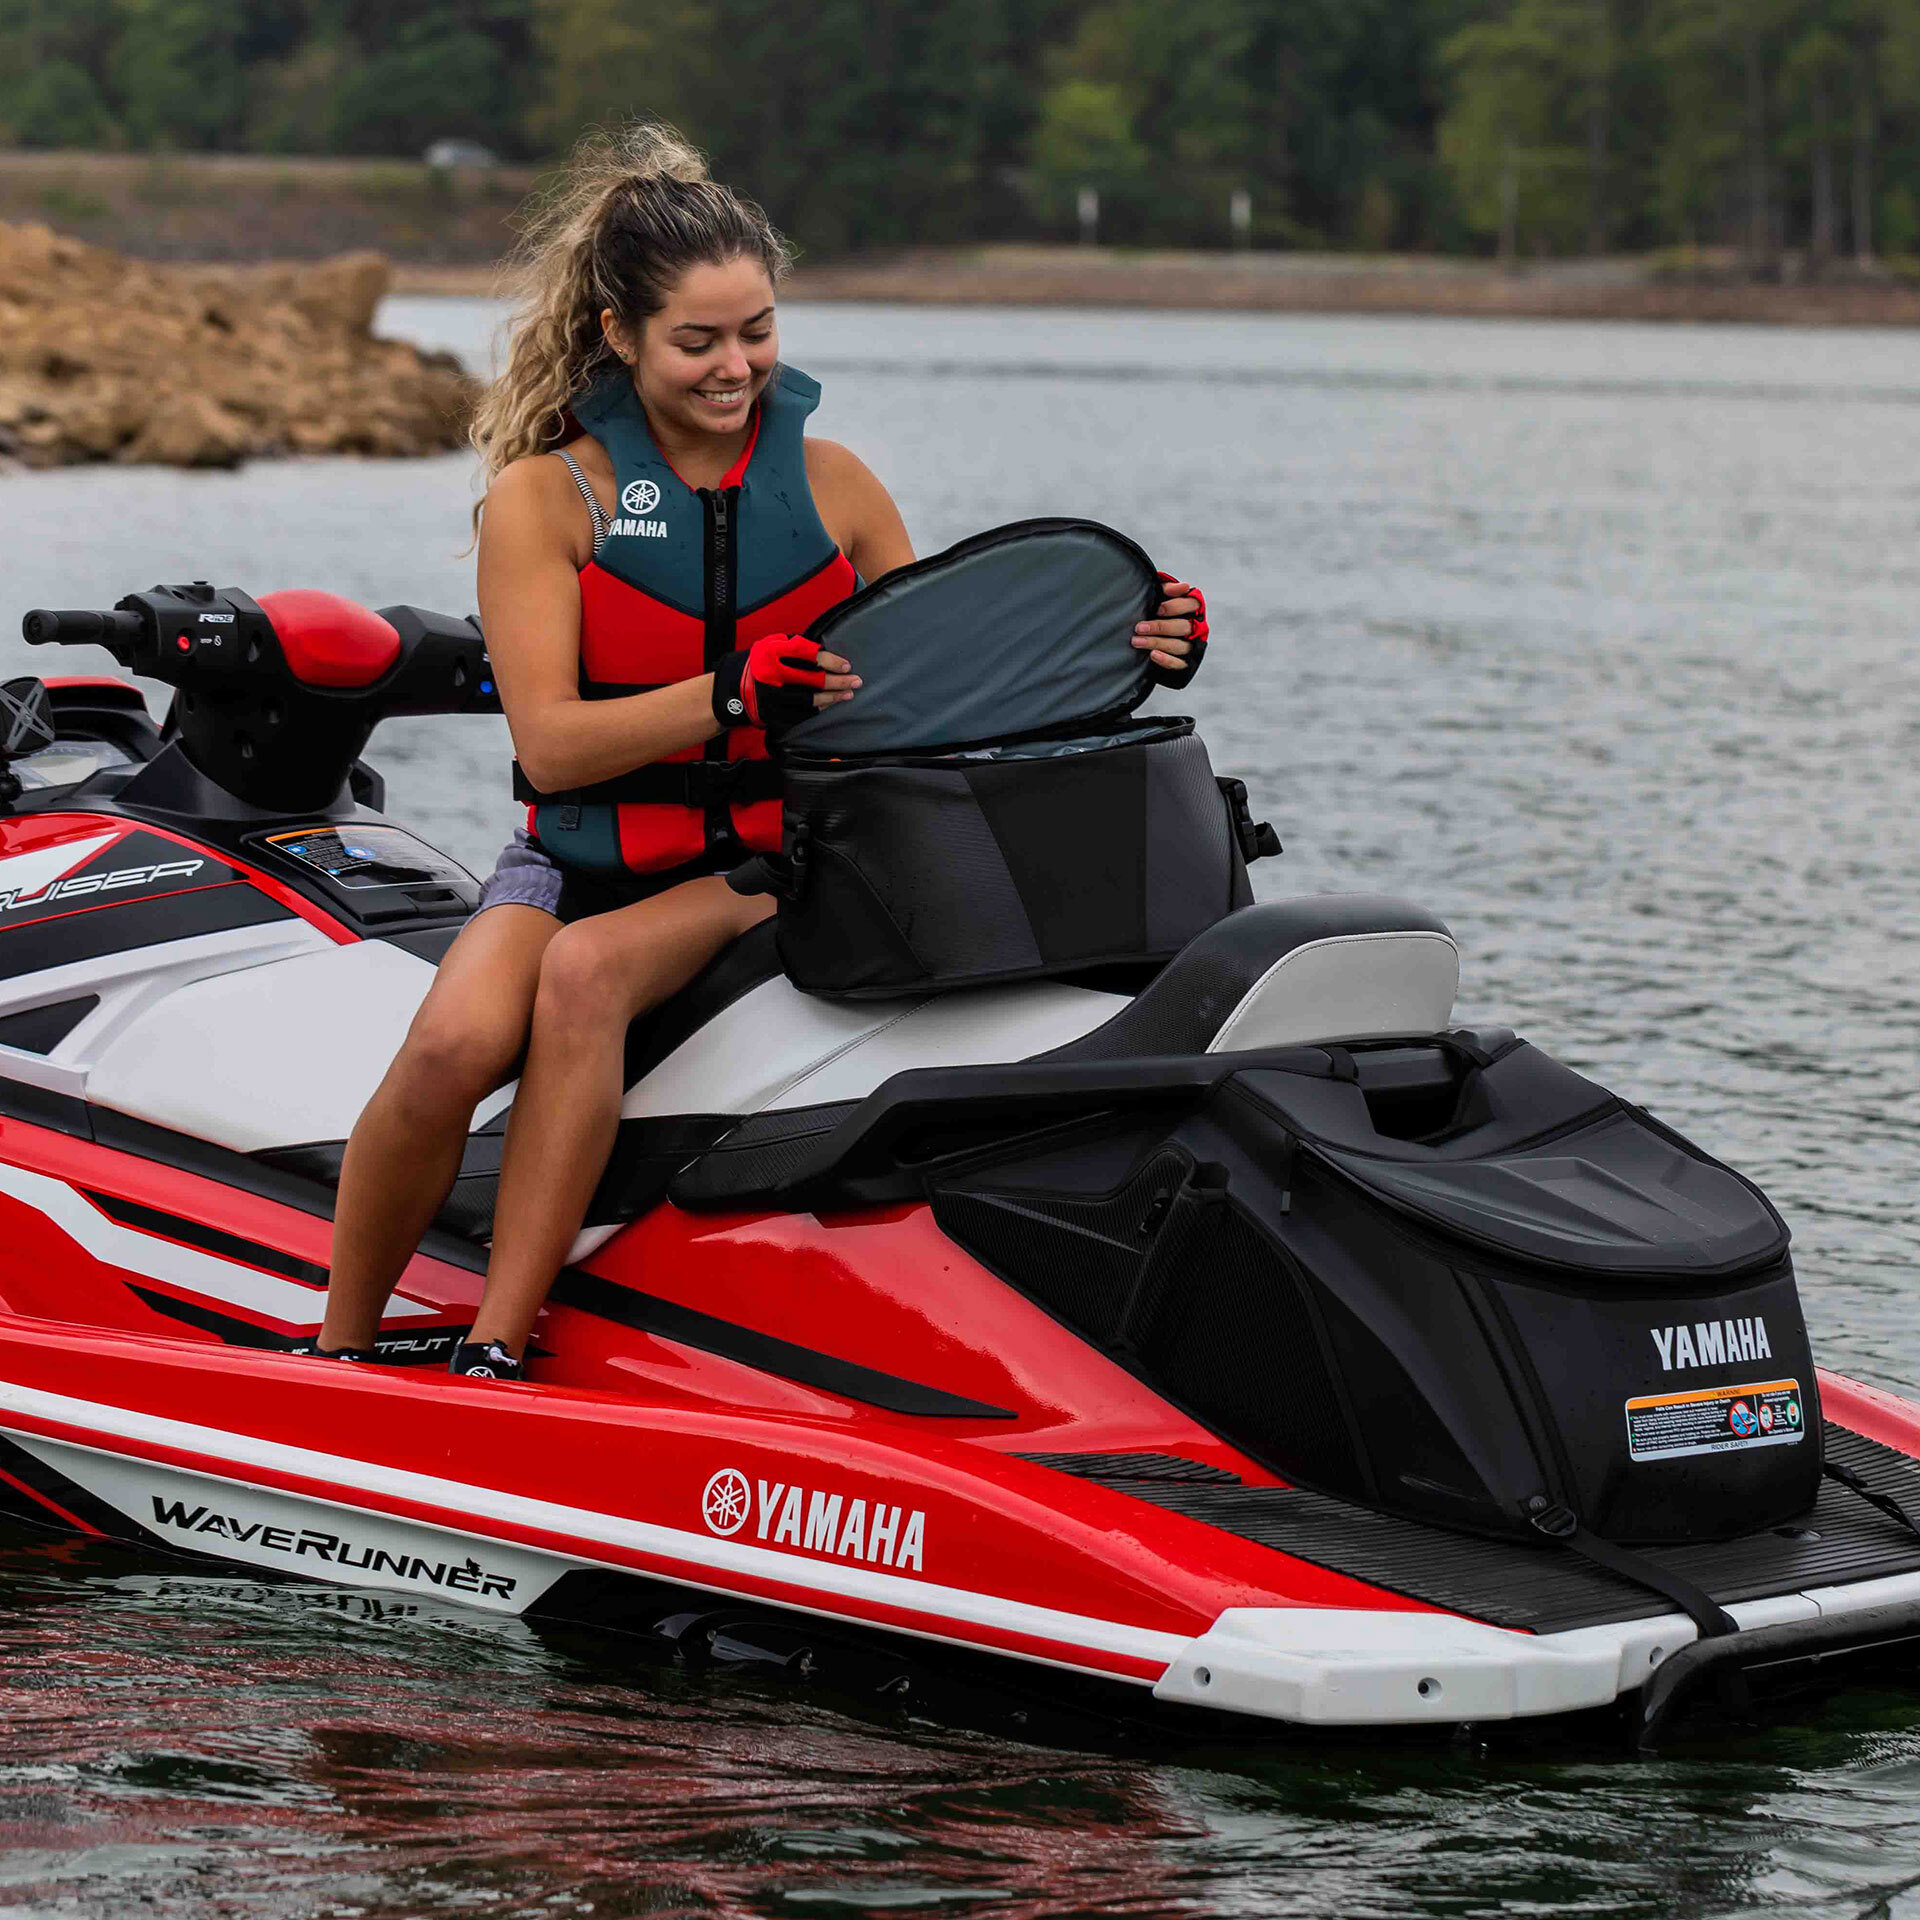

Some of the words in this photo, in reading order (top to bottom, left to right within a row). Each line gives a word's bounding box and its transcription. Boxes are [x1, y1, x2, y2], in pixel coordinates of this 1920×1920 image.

[0, 859, 205, 913] UISER
[1650, 1316, 1772, 1371] YAMAHA
[1711, 1442, 1729, 1451] RIDER
[757, 1479, 925, 1572] YAMAHA
